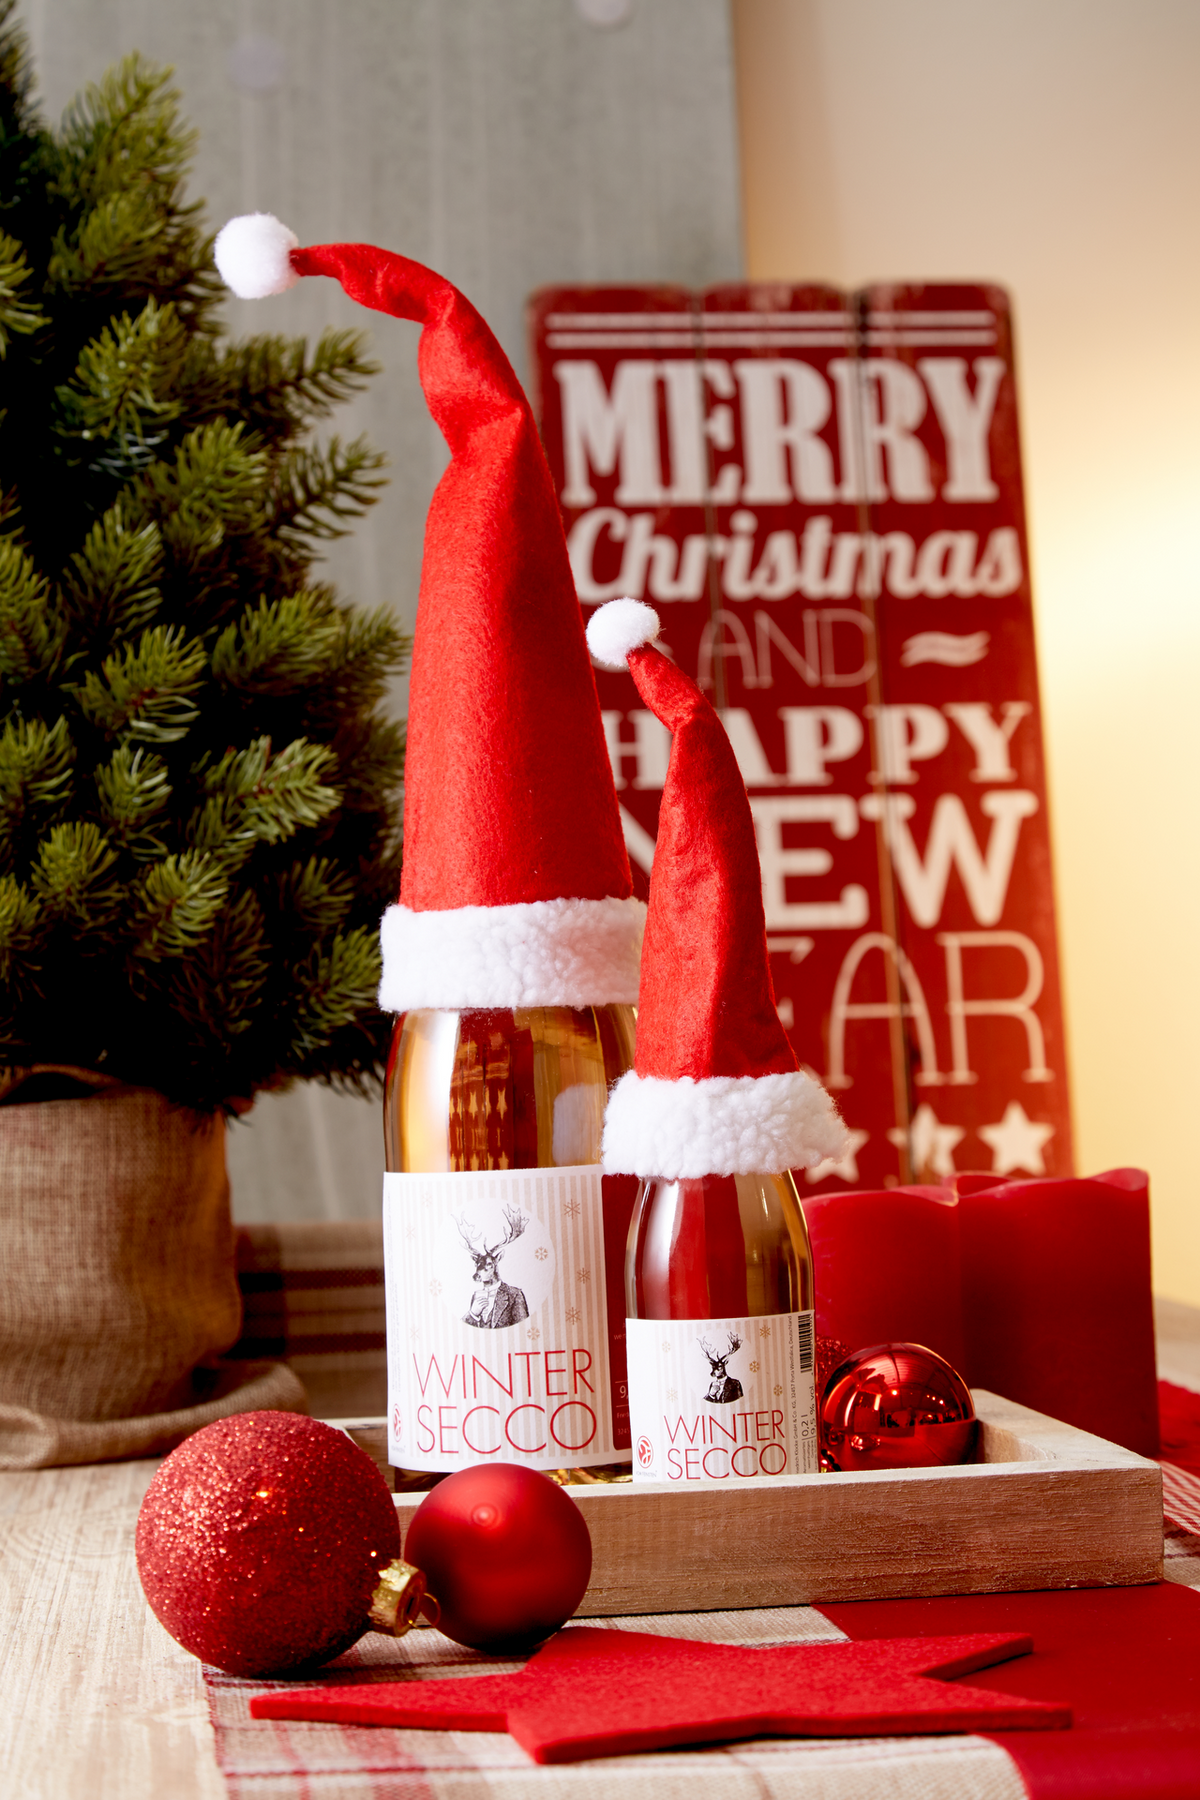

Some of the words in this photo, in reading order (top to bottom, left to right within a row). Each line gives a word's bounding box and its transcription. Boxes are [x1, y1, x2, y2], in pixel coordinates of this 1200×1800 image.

[552, 356, 1006, 507] MERRY
[567, 507, 1023, 604] Christmas
[697, 607, 879, 689] AND
[767, 930, 1055, 1090] AR
[412, 1348, 595, 1399] WINTER
[416, 1400, 597, 1455] SECCO
[664, 1409, 785, 1445] WINTER
[801, 1420, 809, 1437] 0,2
[809, 1403, 815, 1415] %
[667, 1442, 787, 1480] SECCO
